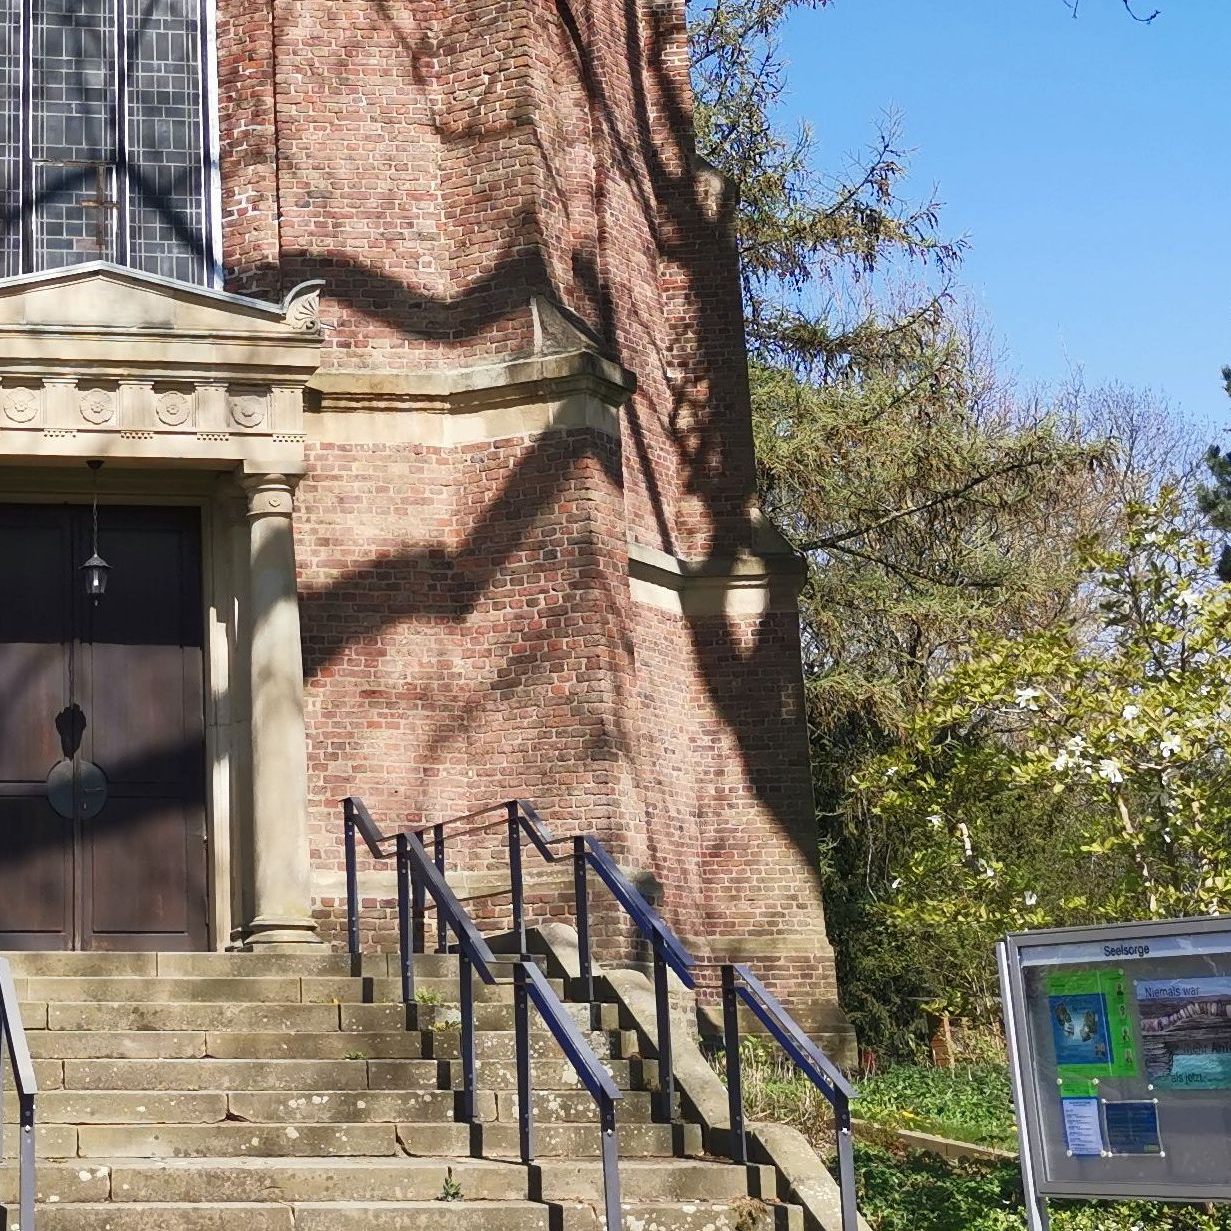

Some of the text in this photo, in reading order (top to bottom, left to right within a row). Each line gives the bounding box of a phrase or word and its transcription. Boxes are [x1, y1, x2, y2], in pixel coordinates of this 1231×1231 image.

[1103, 944, 1150, 957] Seelsorge
[1145, 985, 1200, 998] Niemals war
[1171, 1072, 1184, 1083] als
